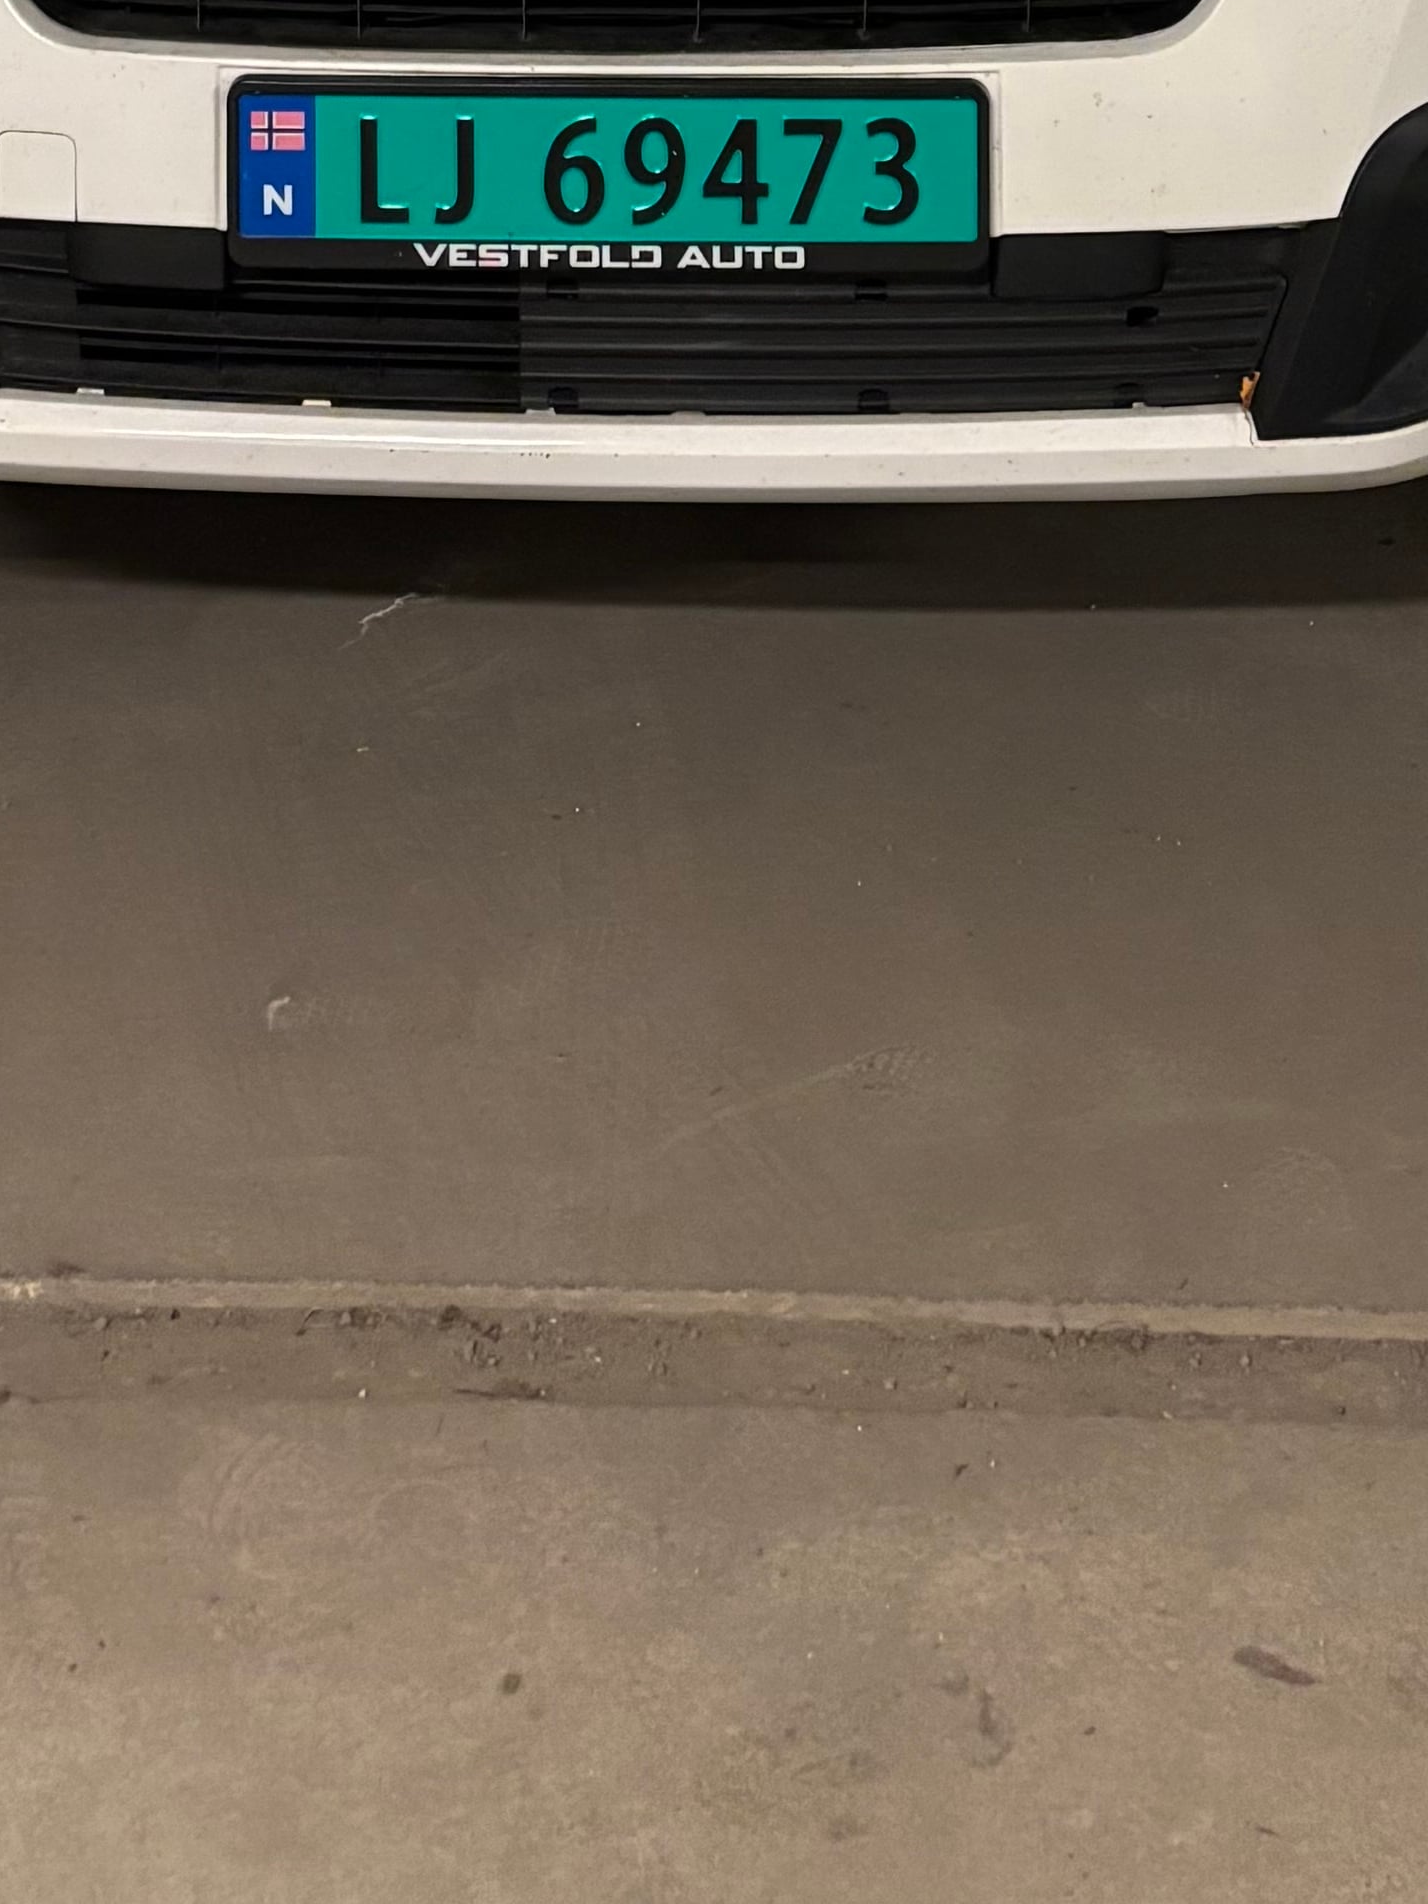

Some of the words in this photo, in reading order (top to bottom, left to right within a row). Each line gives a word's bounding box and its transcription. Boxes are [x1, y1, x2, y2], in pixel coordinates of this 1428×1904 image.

[359, 115, 475, 224] LJ
[543, 116, 920, 226] 69473
[262, 184, 293, 216] N
[413, 242, 663, 270] VESTFOLD
[676, 244, 806, 270] AUTO
